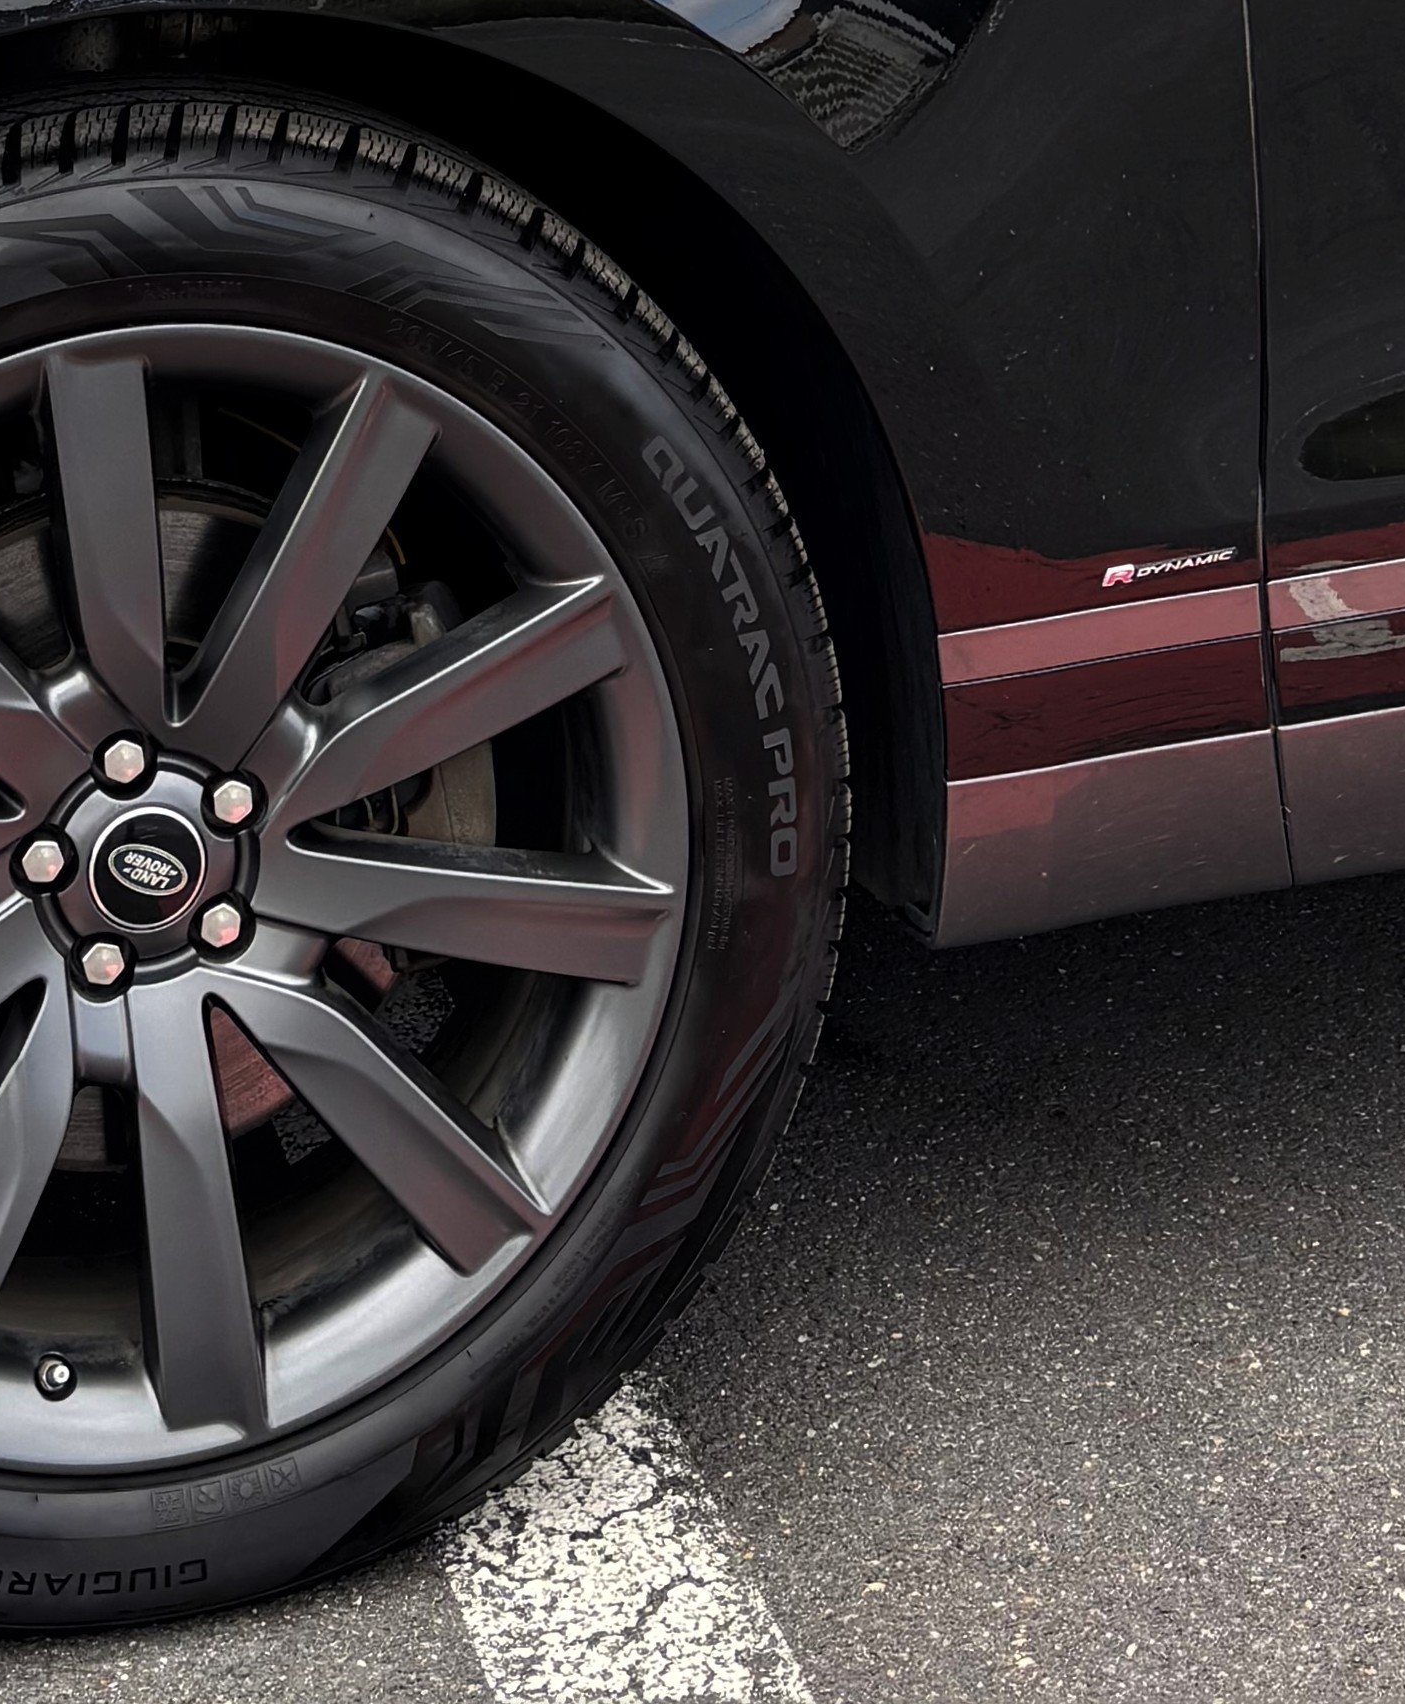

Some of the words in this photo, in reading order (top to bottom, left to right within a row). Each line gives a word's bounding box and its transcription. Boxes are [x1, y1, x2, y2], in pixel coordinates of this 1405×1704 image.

[1137, 550, 1234, 578] DYNAMIC
[641, 434, 785, 721] QUATRAC
[762, 727, 798, 878] PRO
[123, 851, 172, 877] ROVER
[130, 868, 171, 889] LAND
